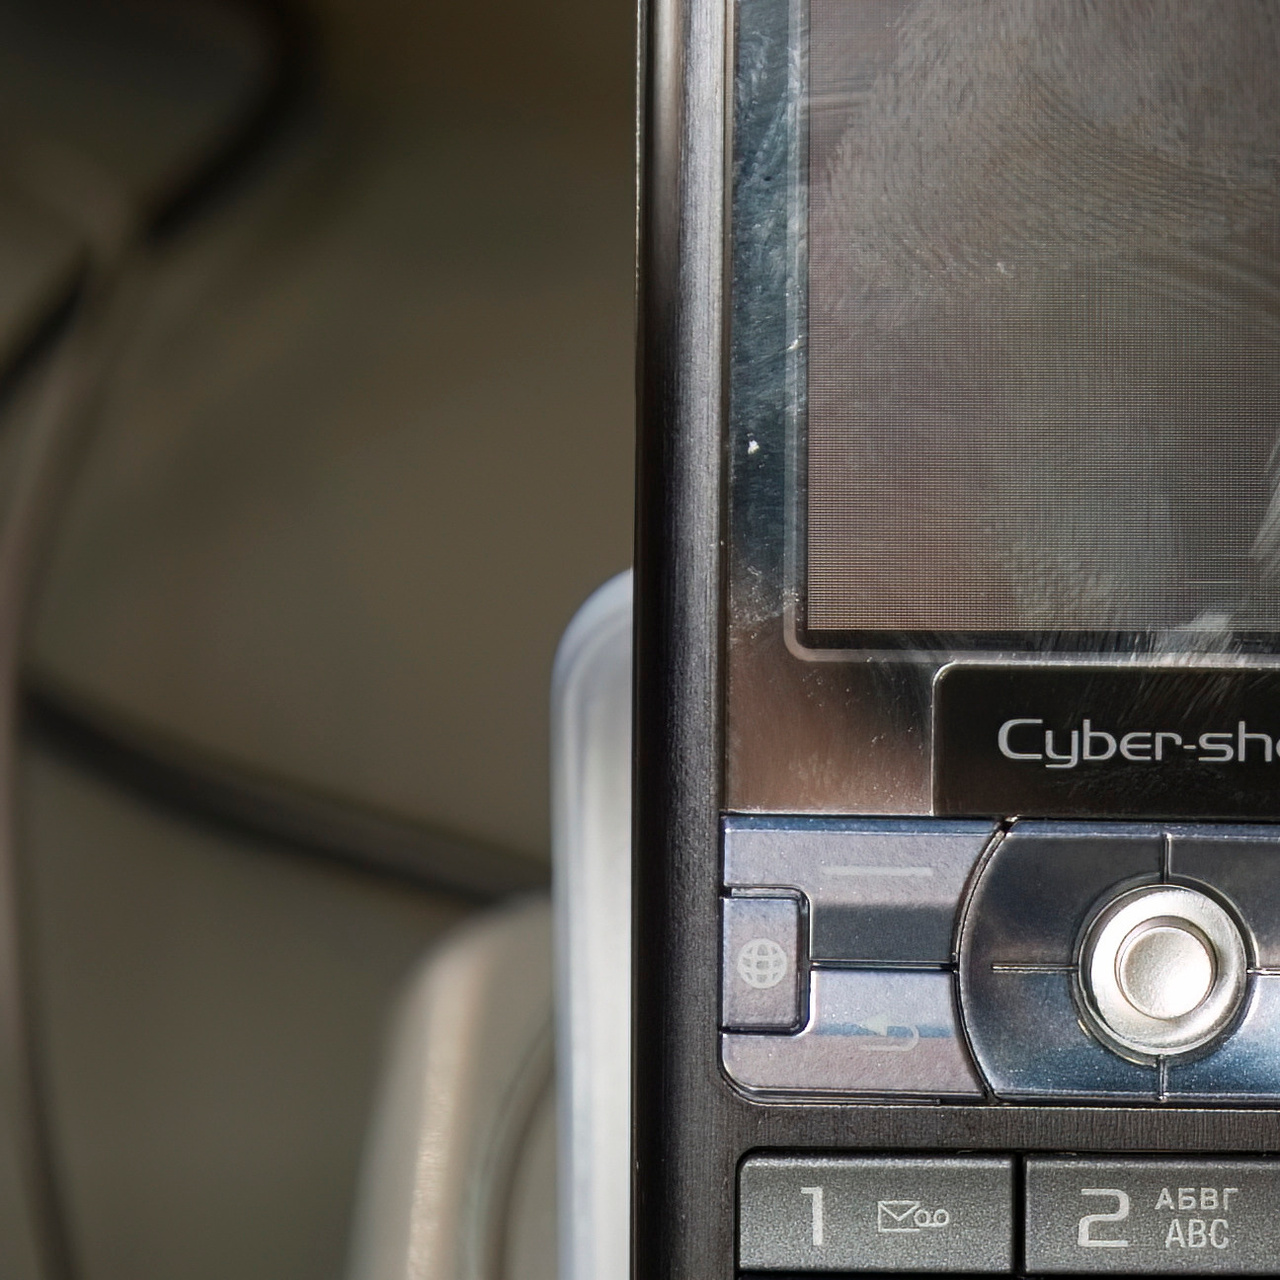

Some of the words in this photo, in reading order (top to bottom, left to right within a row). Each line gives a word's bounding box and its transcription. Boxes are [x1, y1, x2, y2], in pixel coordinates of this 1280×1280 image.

[800, 1186, 825, 1247] 1
[1076, 1187, 1130, 1248] 2
[1154, 1187, 1240, 1212] АБВГ
[1164, 1216, 1230, 1249] ABC
